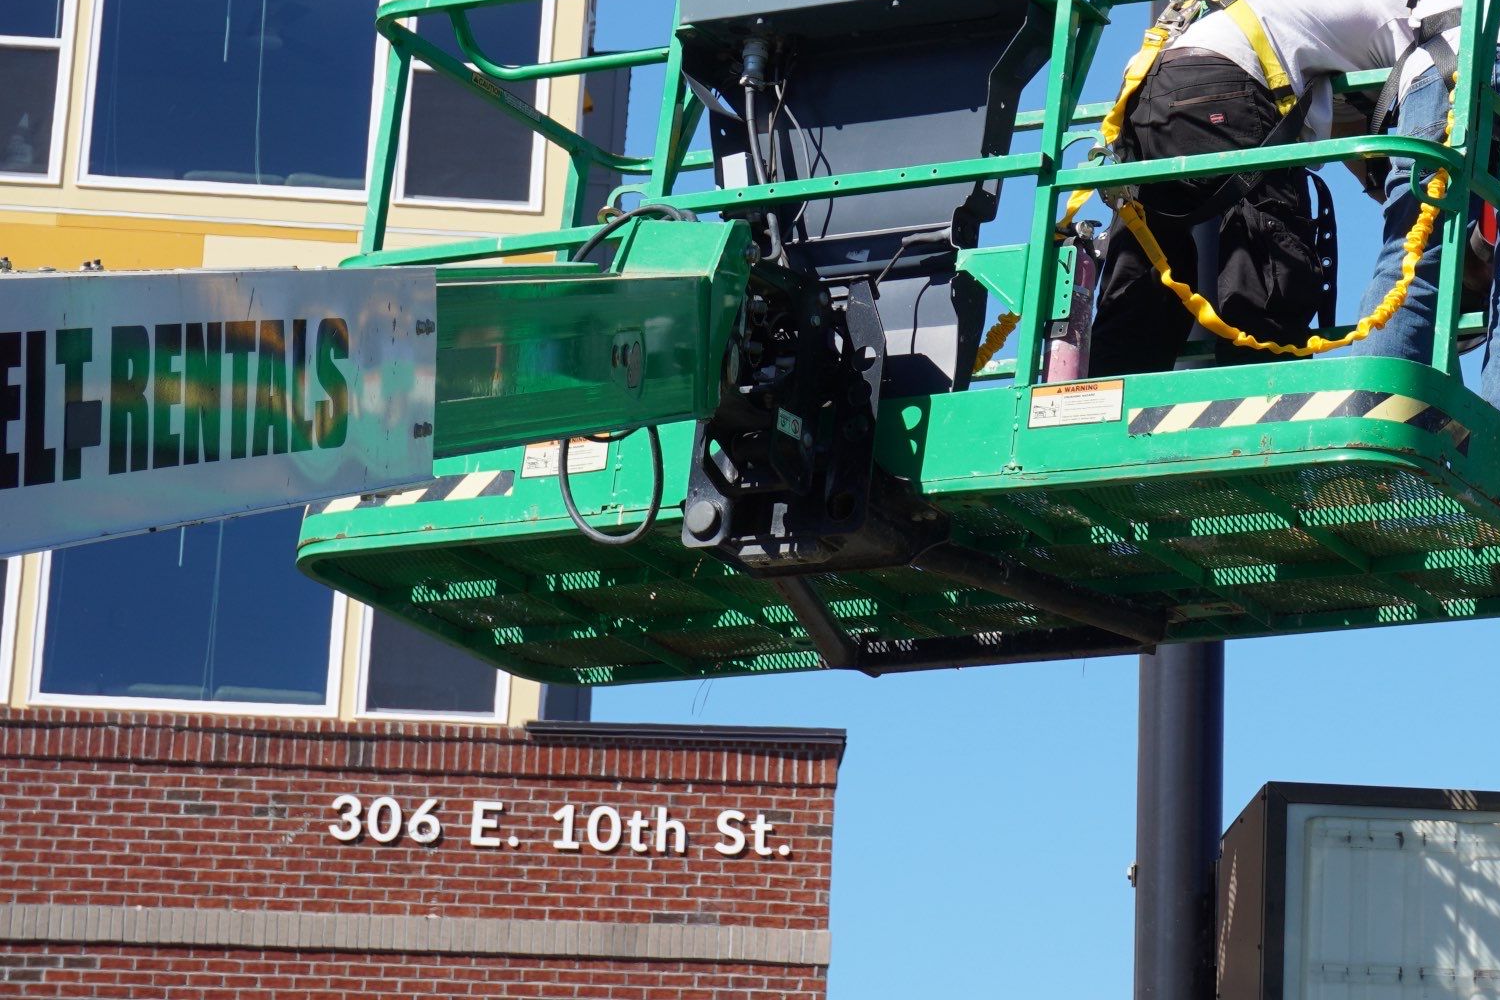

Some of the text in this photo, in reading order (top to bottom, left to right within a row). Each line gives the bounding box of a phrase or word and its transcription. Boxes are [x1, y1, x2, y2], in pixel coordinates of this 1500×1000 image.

[108, 318, 349, 475] RENTALS
[1064, 384, 1098, 393] WARNING
[328, 794, 791, 856] 306 E. 10th St.
